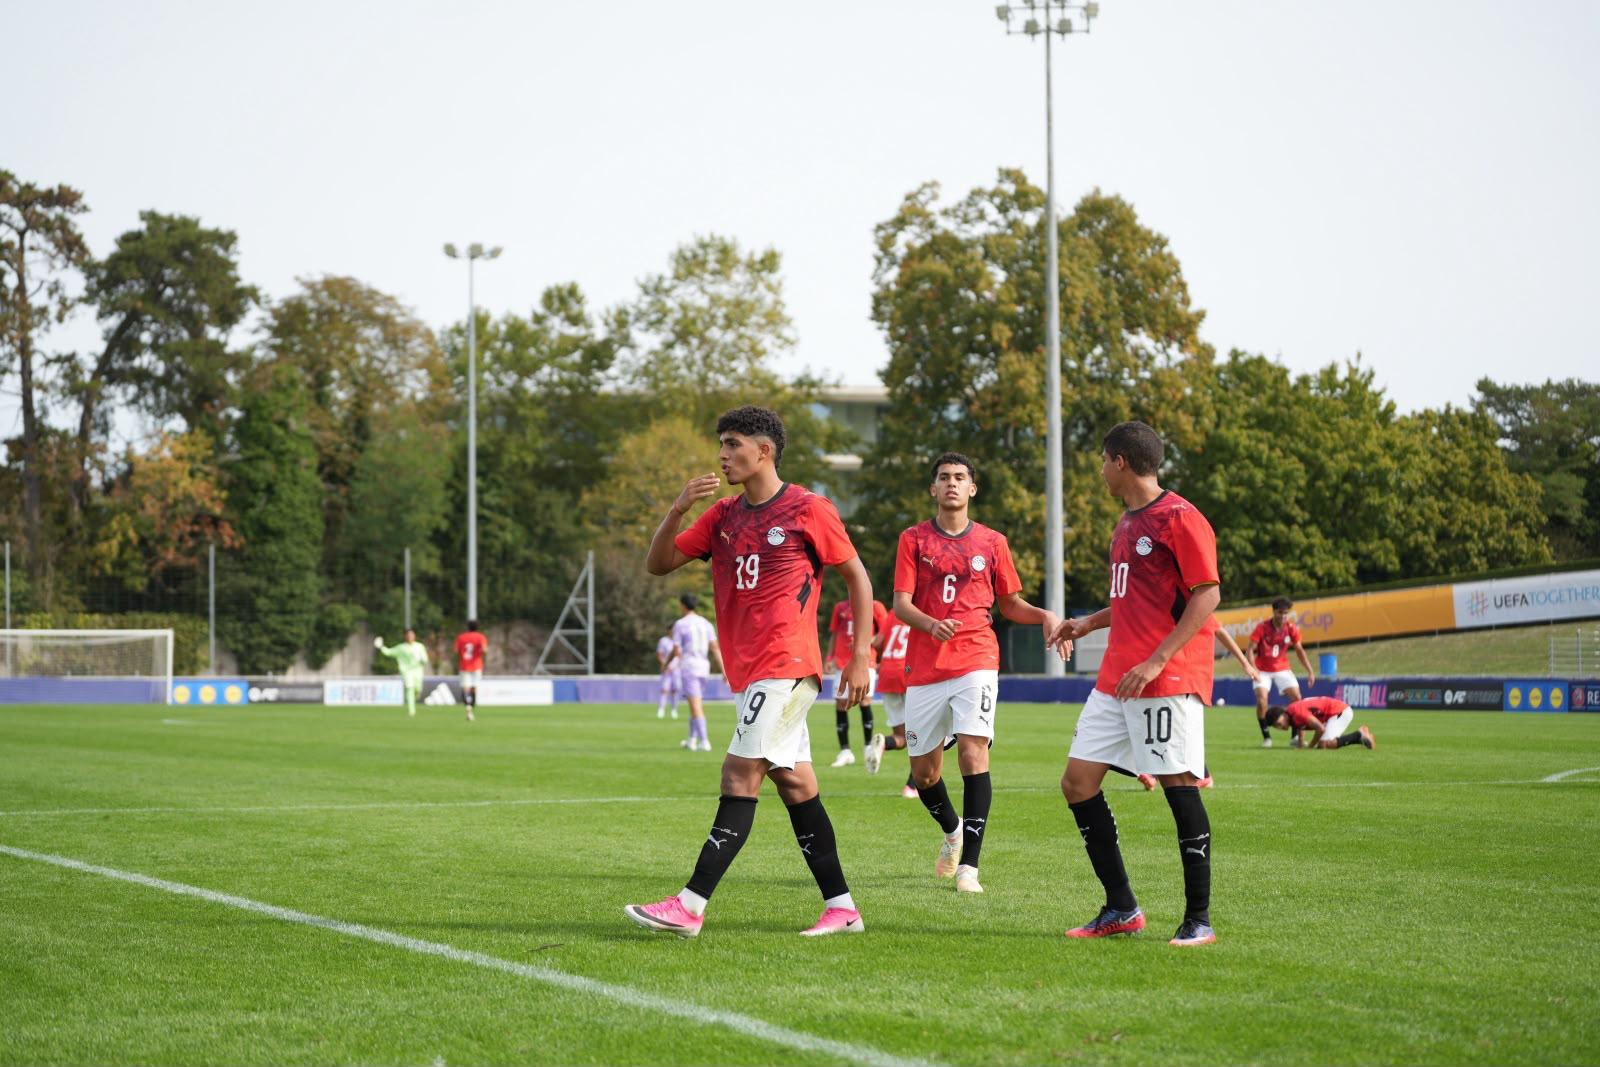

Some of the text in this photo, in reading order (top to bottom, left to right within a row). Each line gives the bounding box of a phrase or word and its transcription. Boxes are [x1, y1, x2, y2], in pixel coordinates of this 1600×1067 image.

[735, 554, 760, 590] 19
[943, 574, 957, 604] 6
[1110, 563, 1129, 598] 10
[883, 625, 911, 659] 15
[981, 685, 992, 713] 6
[1143, 706, 1172, 745] 10
